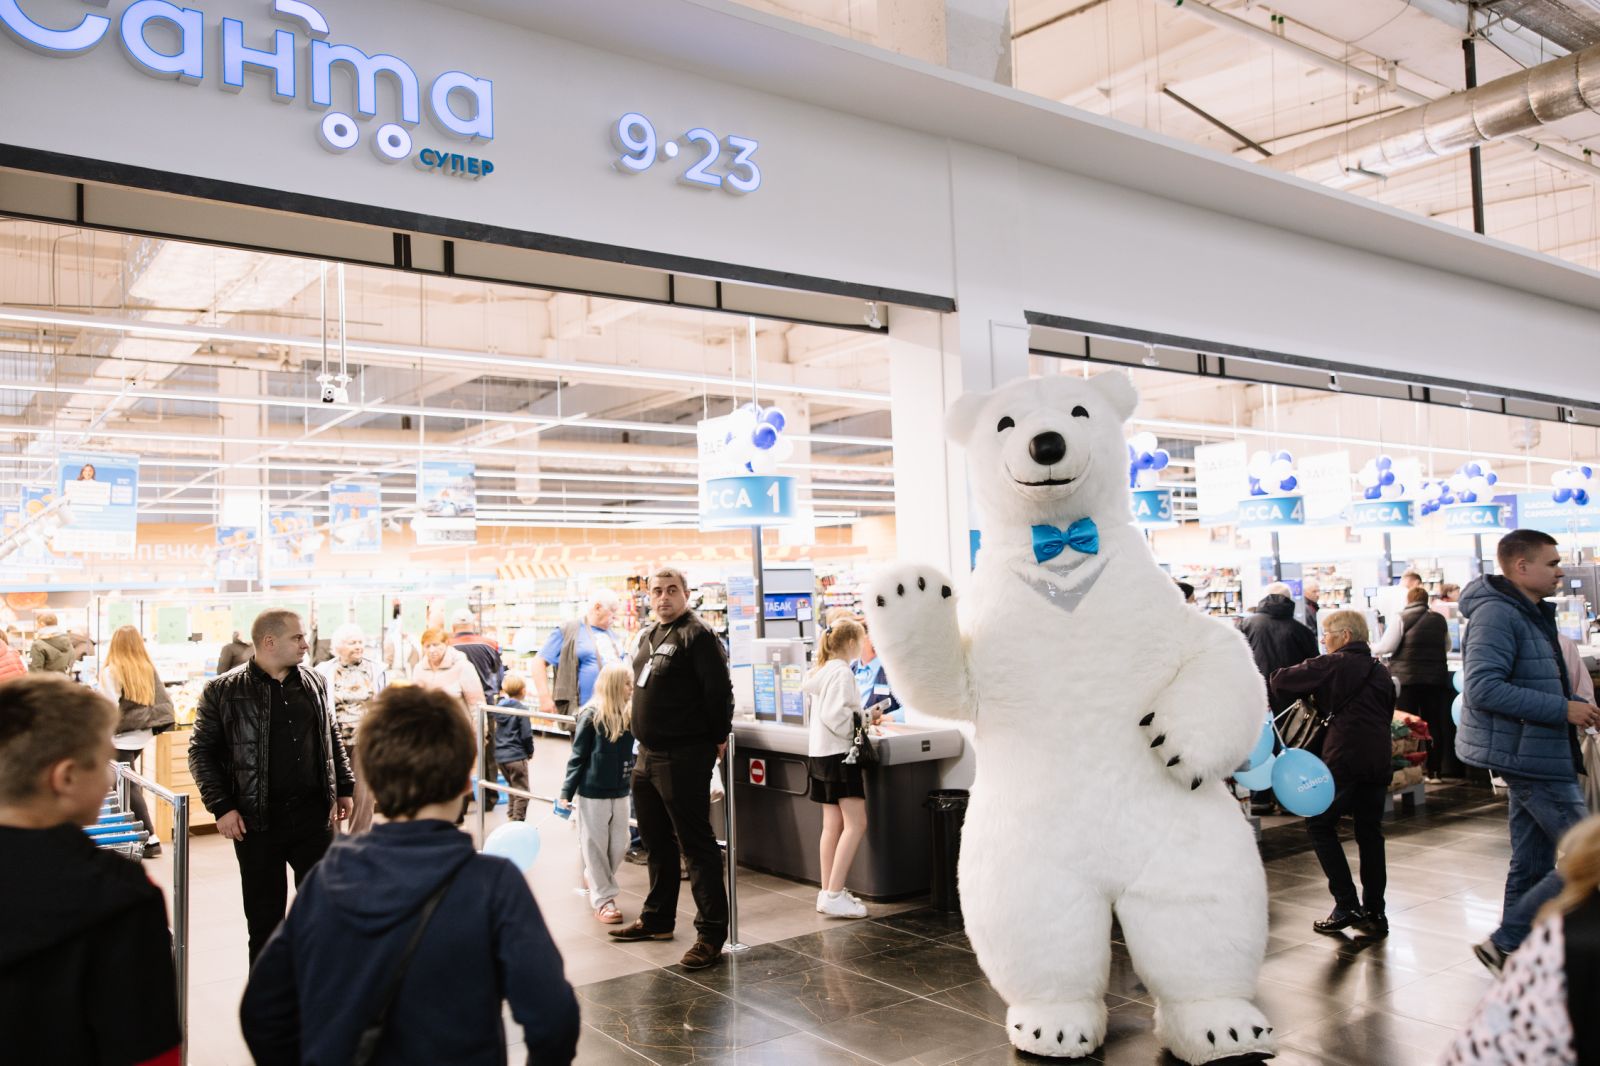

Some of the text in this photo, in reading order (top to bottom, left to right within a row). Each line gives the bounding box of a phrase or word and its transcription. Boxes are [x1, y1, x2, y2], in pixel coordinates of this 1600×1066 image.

[420, 148, 494, 176] СУПЕР
[709, 481, 780, 513] ССА 1
[1157, 494, 1170, 519] 3
[1240, 501, 1304, 523] ССА 4
[764, 601, 792, 612] ТАБАК
